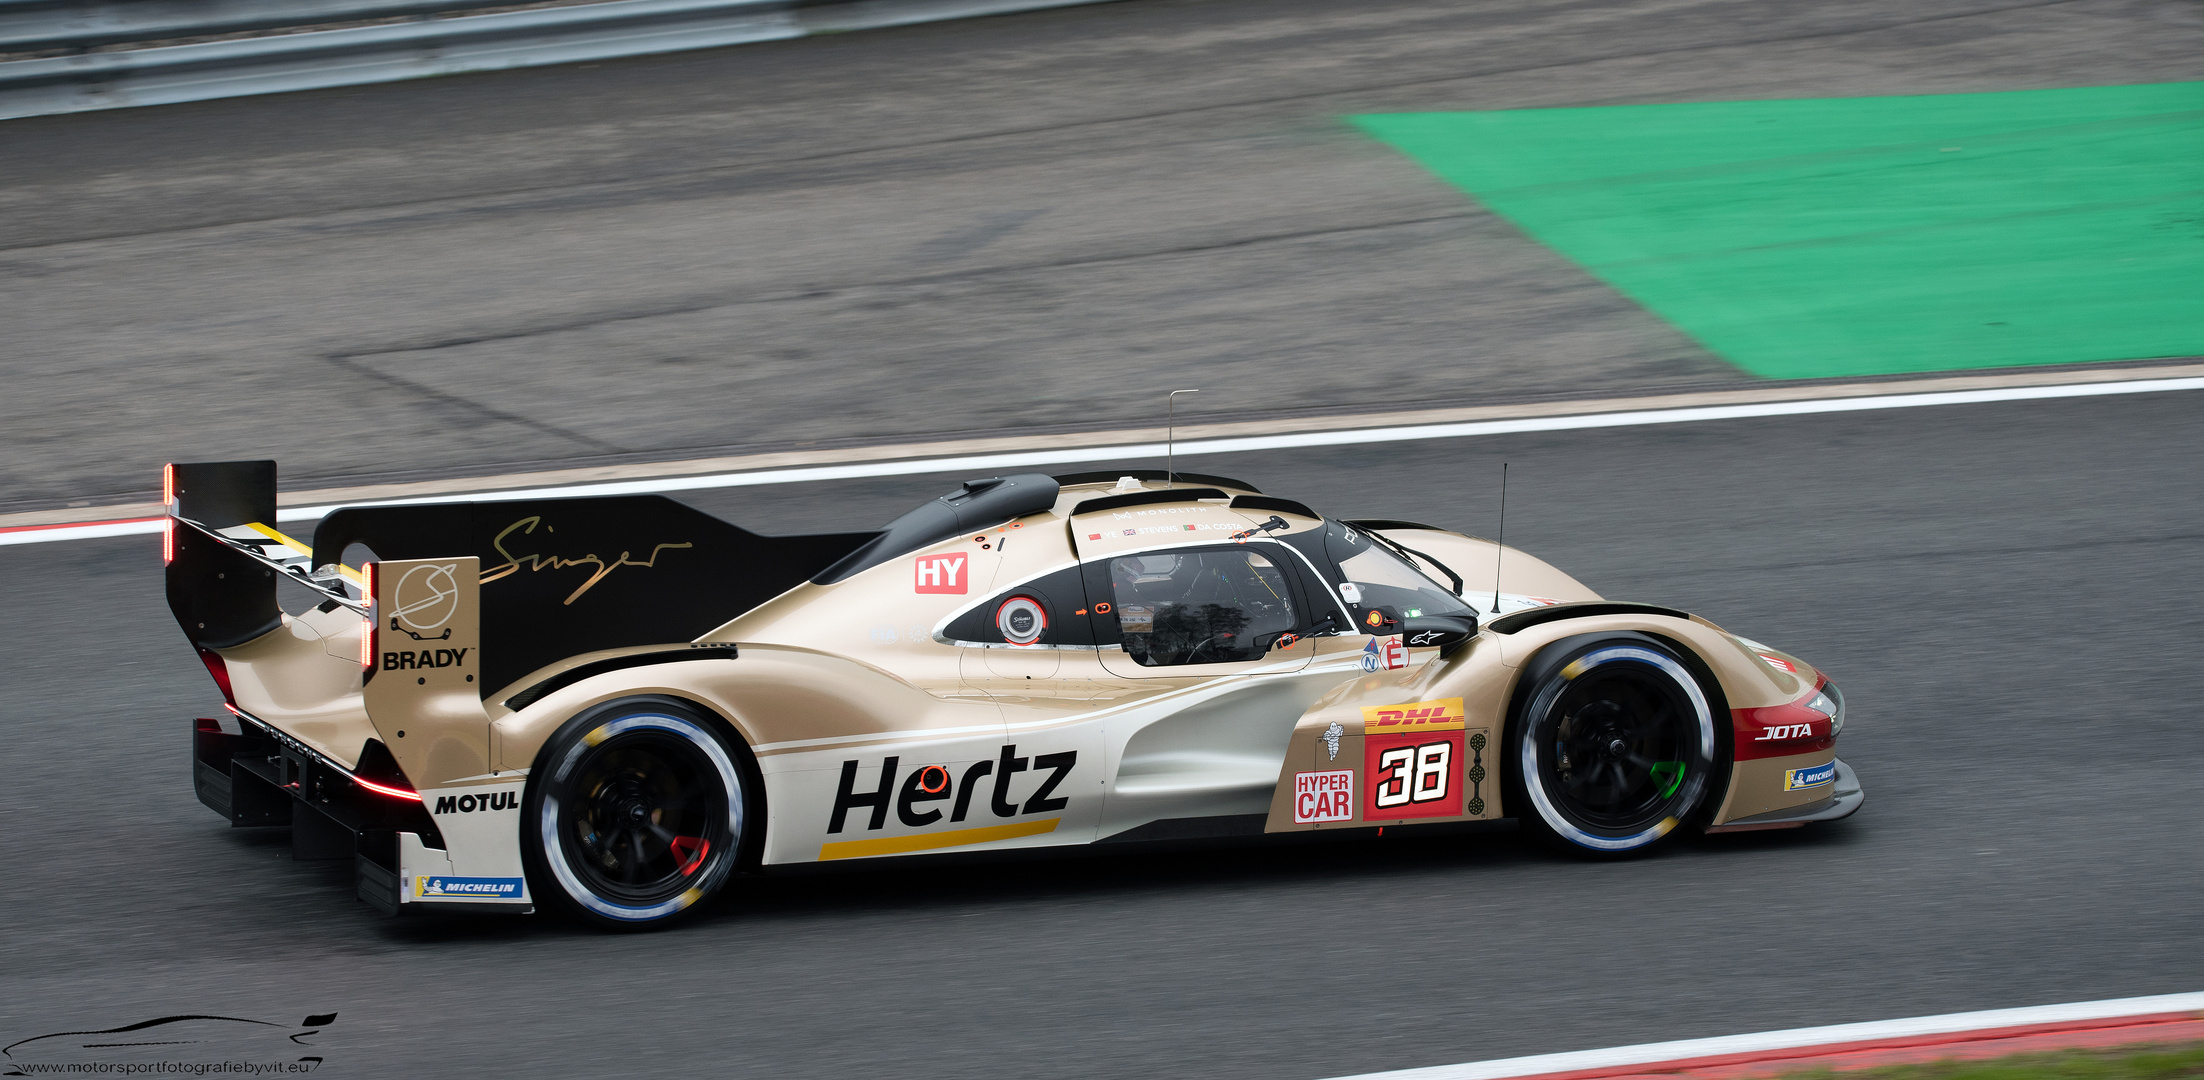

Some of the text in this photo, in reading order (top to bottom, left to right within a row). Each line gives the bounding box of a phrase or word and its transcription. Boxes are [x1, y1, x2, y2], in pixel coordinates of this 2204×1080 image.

[1137, 507, 1207, 517] MONOLITH
[1104, 531, 1117, 539] YE
[1139, 525, 1178, 535] STEVENS
[1198, 523, 1243, 532] DA COSTA
[918, 557, 965, 586] HY
[871, 628, 897, 641] FIA
[1365, 656, 1375, 670] N
[1377, 706, 1452, 726] DHL
[1755, 723, 1812, 741] JOTA
[263, 725, 322, 764] PORSCHE
[1298, 774, 1349, 793] HYPER
[1375, 740, 1453, 810] 38
[826, 744, 1077, 834] Hertz
[434, 791, 519, 814] MOTUL
[1298, 788, 1350, 819] CAR
[445, 883, 515, 892] MICHELIN
